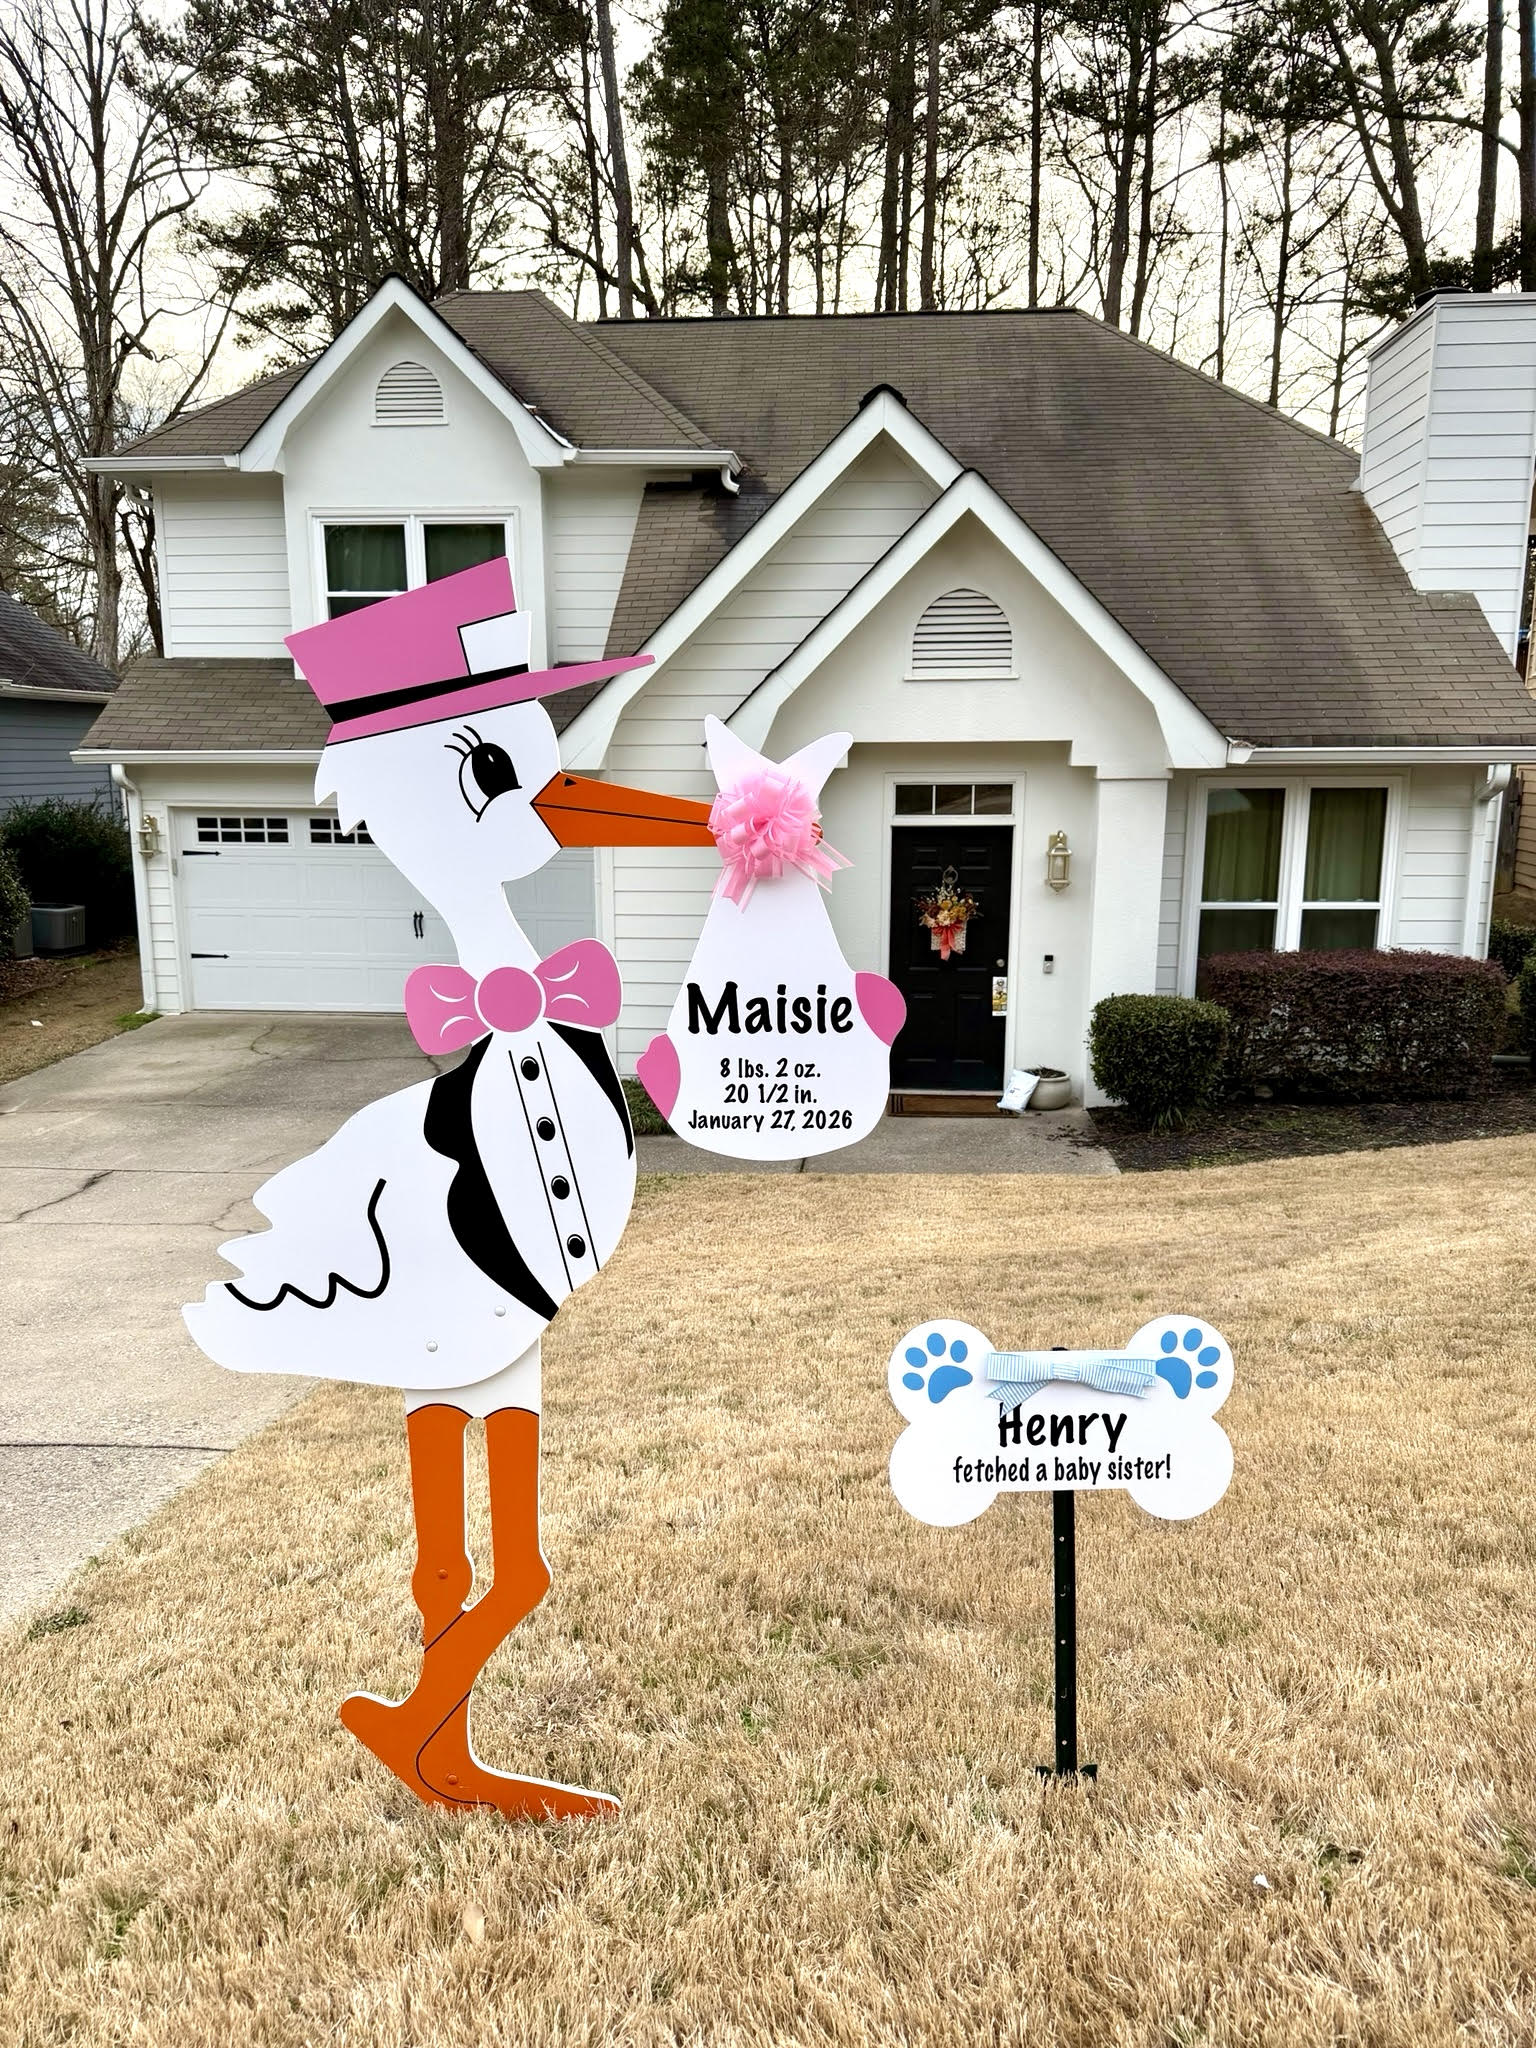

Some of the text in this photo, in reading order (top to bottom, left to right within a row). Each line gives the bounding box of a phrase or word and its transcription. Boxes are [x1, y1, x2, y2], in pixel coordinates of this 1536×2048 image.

[686, 981, 854, 1035] Maisie
[720, 1057, 821, 1079] 8 lbs. 2 oz.
[724, 1083, 818, 1104] 20 1/2 in.
[687, 1109, 853, 1133] January 27, 2026
[998, 1402, 1128, 1453] Henry
[952, 1453, 1171, 1486] fetched a baby sister!
